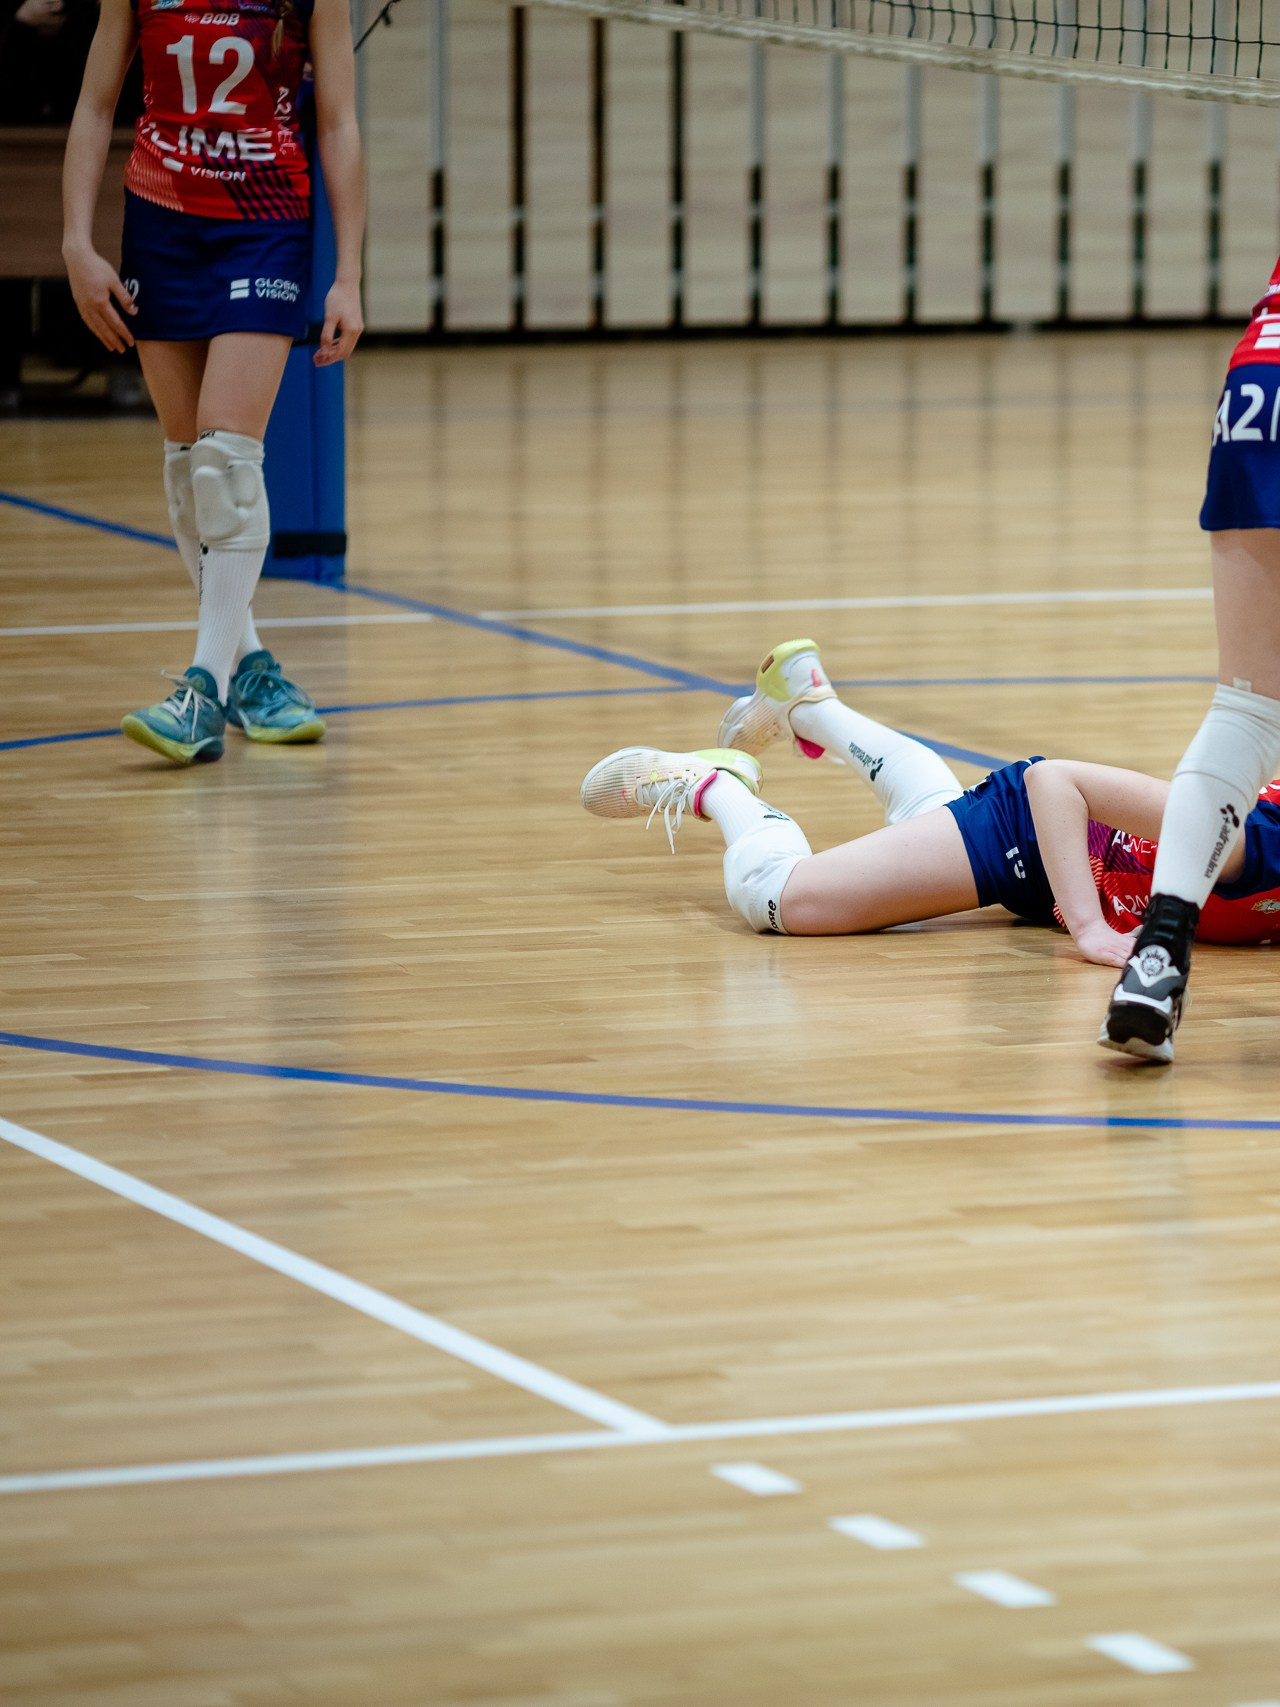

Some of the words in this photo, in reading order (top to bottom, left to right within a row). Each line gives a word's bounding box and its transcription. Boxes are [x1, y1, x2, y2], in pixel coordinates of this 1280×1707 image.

[200, 13, 240, 26] ВФВ
[166, 35, 255, 115] 12
[150, 124, 276, 162] LIME
[190, 166, 247, 181] VISION
[255, 277, 300, 294] GLOBAL
[255, 287, 297, 302] VISION
